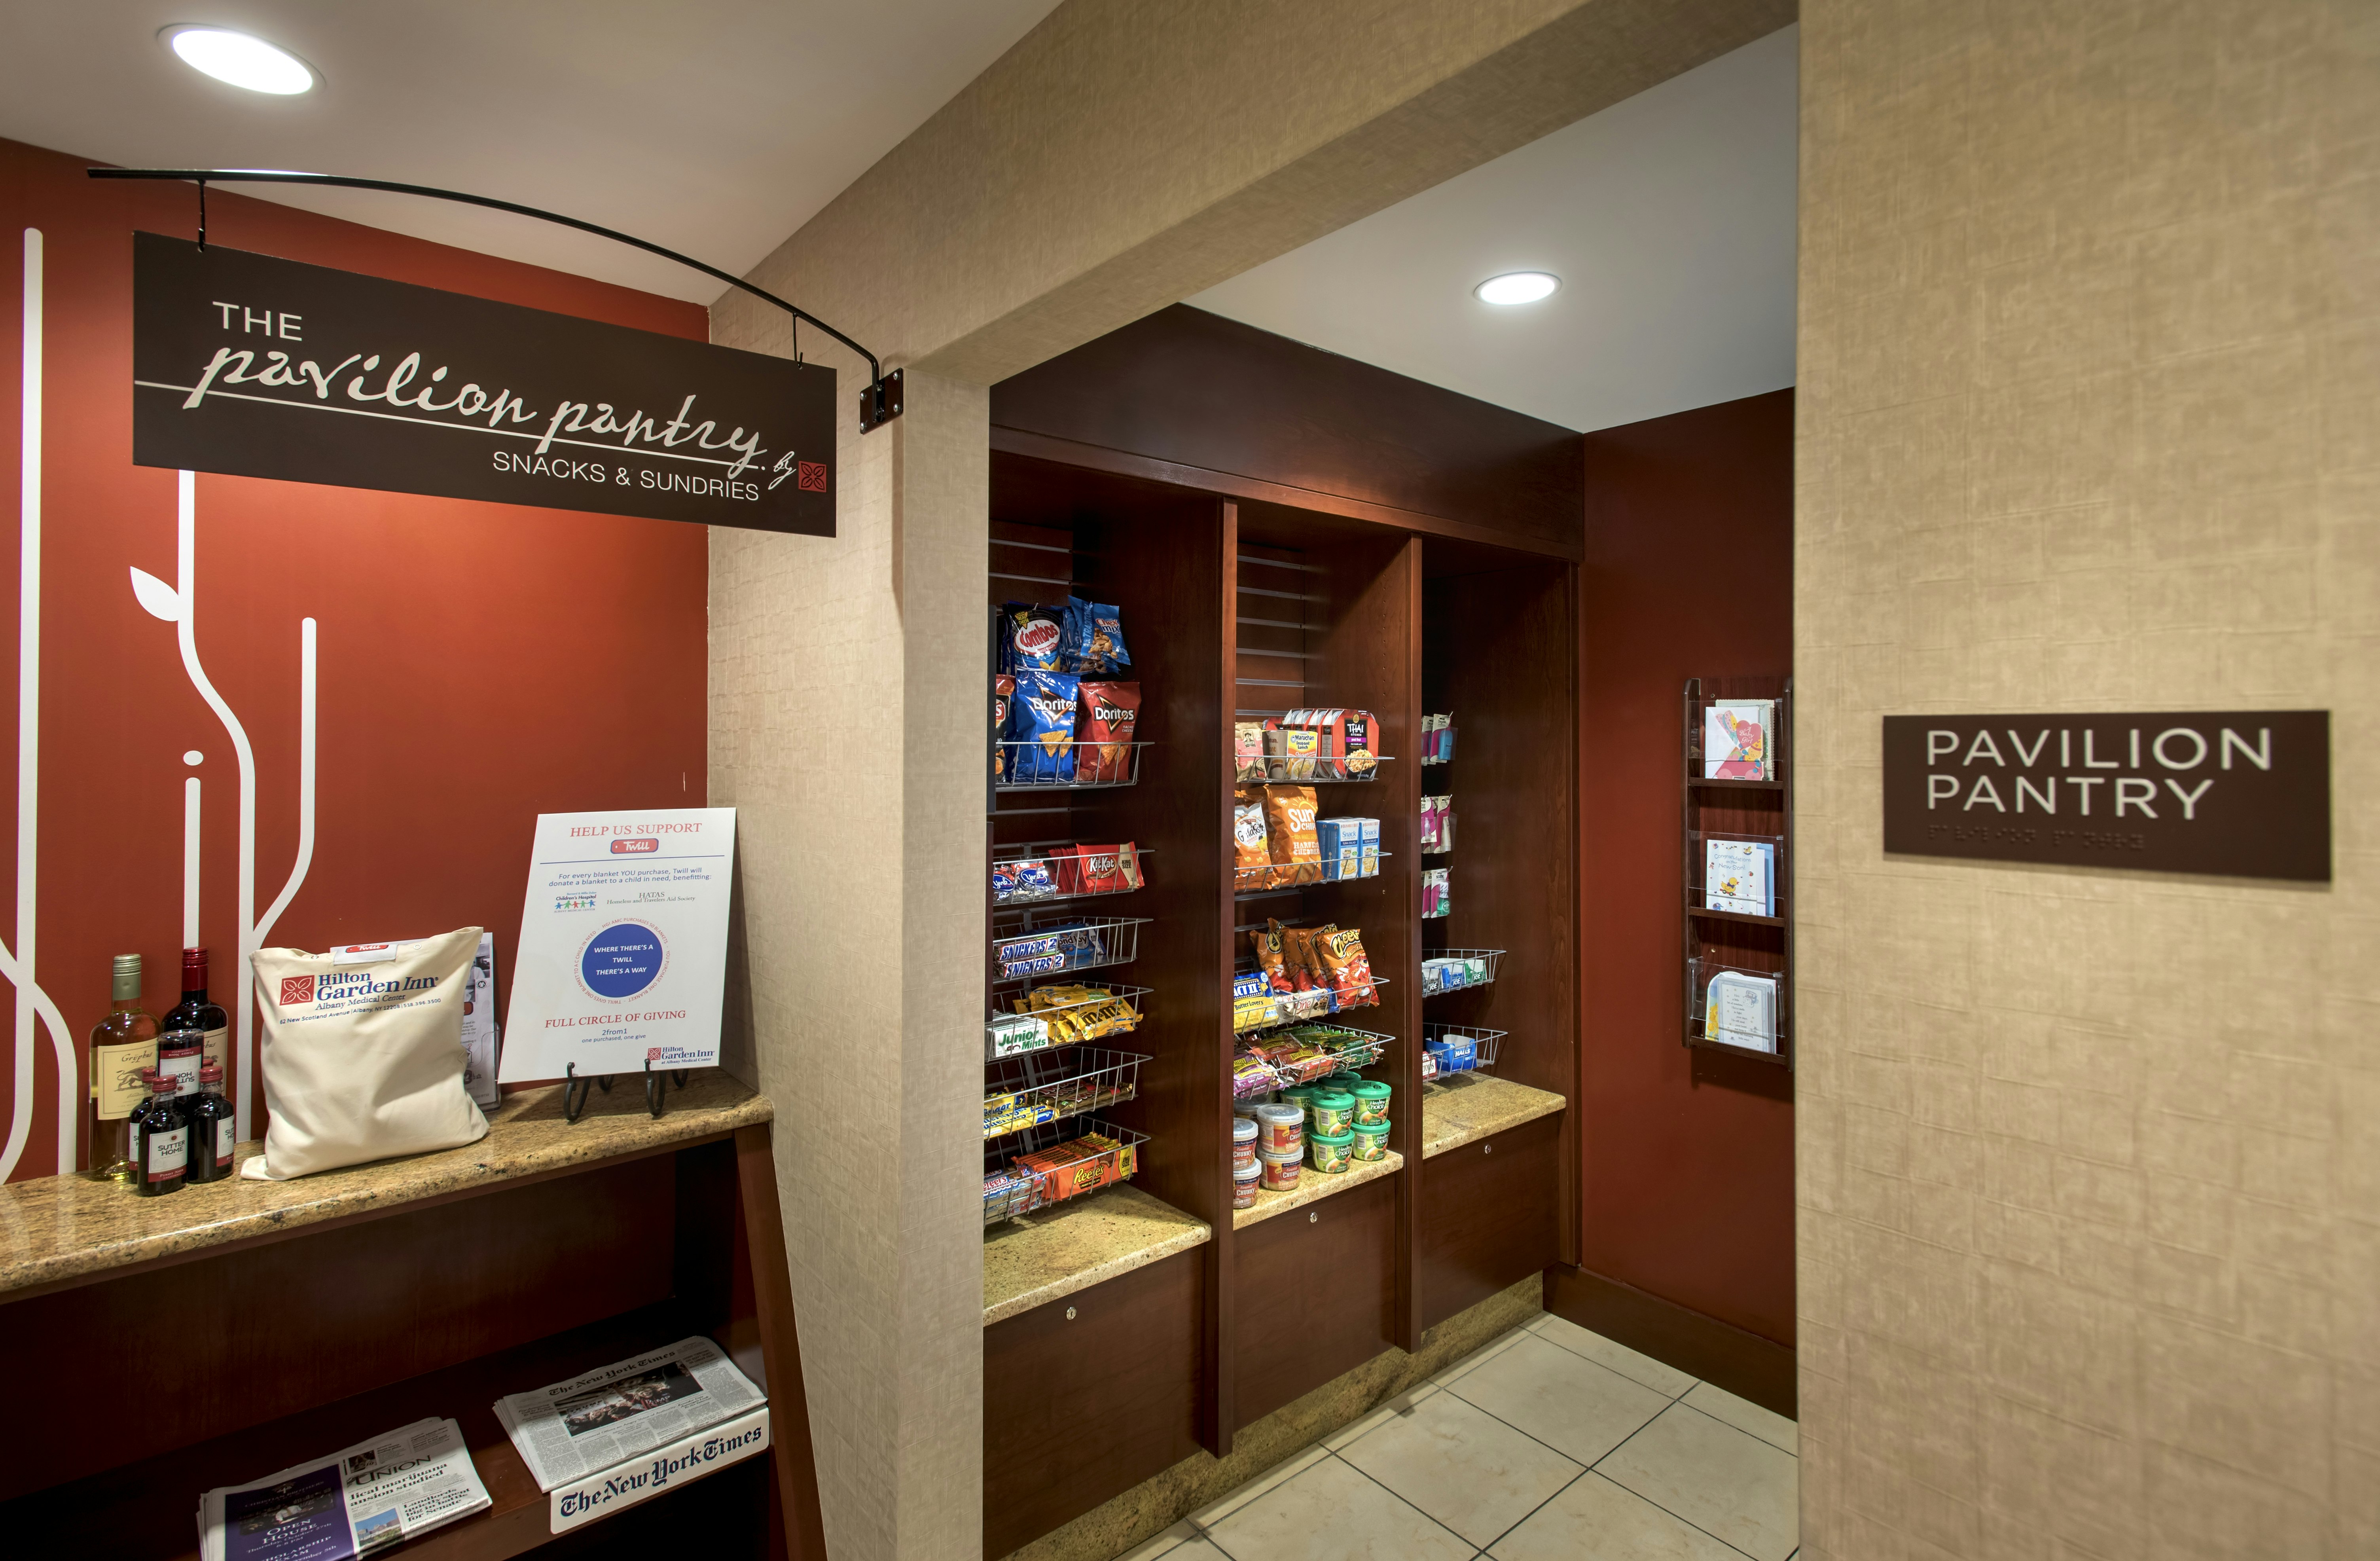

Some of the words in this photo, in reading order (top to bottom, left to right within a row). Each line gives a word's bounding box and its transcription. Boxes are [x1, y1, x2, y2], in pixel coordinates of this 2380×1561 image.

[212, 301, 303, 341] THE
[183, 346, 537, 427] pavilion
[768, 451, 796, 489] by
[493, 451, 606, 484] SNACKS
[616, 466, 631, 486] &
[639, 469, 759, 502] SUNDRIES
[1020, 624, 1058, 647] Combos
[1101, 625, 1120, 634] mix
[1094, 707, 1134, 721] Doritos
[1347, 724, 1364, 733] THAI
[1740, 730, 1754, 738] Baby
[1927, 728, 2271, 770] PAVILION
[1927, 775, 2214, 820] PANTRY
[1288, 808, 1315, 833] Sun
[570, 827, 609, 837] HELP
[613, 825, 632, 835] US
[637, 823, 702, 834] SUPPORT
[623, 841, 650, 851] Twill
[654, 926, 668, 944] BLANKETS
[1000, 940, 1046, 960] SNICKERS
[1006, 957, 1053, 977] SNICKERS
[318, 972, 371, 986] Hilton
[316, 979, 400, 1001] Garden
[402, 977, 437, 991] Inn
[315, 1001, 345, 1010] Albany
[348, 996, 380, 1006] Medical
[1234, 1002, 1249, 1010] Butter
[545, 1019, 575, 1028] FULL
[579, 1015, 622, 1026] CIRCLE
[625, 1013, 640, 1022] OF
[644, 1010, 686, 1020] GIVING
[999, 1030, 1039, 1046] Junior
[1021, 1038, 1046, 1050] Mints
[662, 1051, 695, 1060] Garden
[1455, 1048, 1471, 1057] HALLS
[158, 1140, 185, 1151] SUTTER
[1374, 1137, 1387, 1145] Choice
[161, 1146, 183, 1156] HOME
[548, 1385, 573, 1396] The
[576, 1375, 603, 1388] New
[606, 1364, 637, 1380] York
[637, 1351, 675, 1367] Times
[356, 1455, 431, 1485] UNION
[382, 1464, 447, 1489] marijuana
[561, 1489, 602, 1517] The
[603, 1472, 648, 1503] New
[650, 1446, 703, 1487] York
[703, 1426, 762, 1461] Times
[396, 1470, 443, 1491] studied
[404, 1488, 457, 1508] Landlords
[404, 1496, 442, 1513] quietly
[442, 1488, 471, 1500] spent
[406, 1507, 423, 1517] big
[407, 1513, 424, 1522] for
[426, 1499, 462, 1515] Senate
[262, 1523, 317, 1544] HOUSE
[267, 1519, 311, 1535] OPEN
